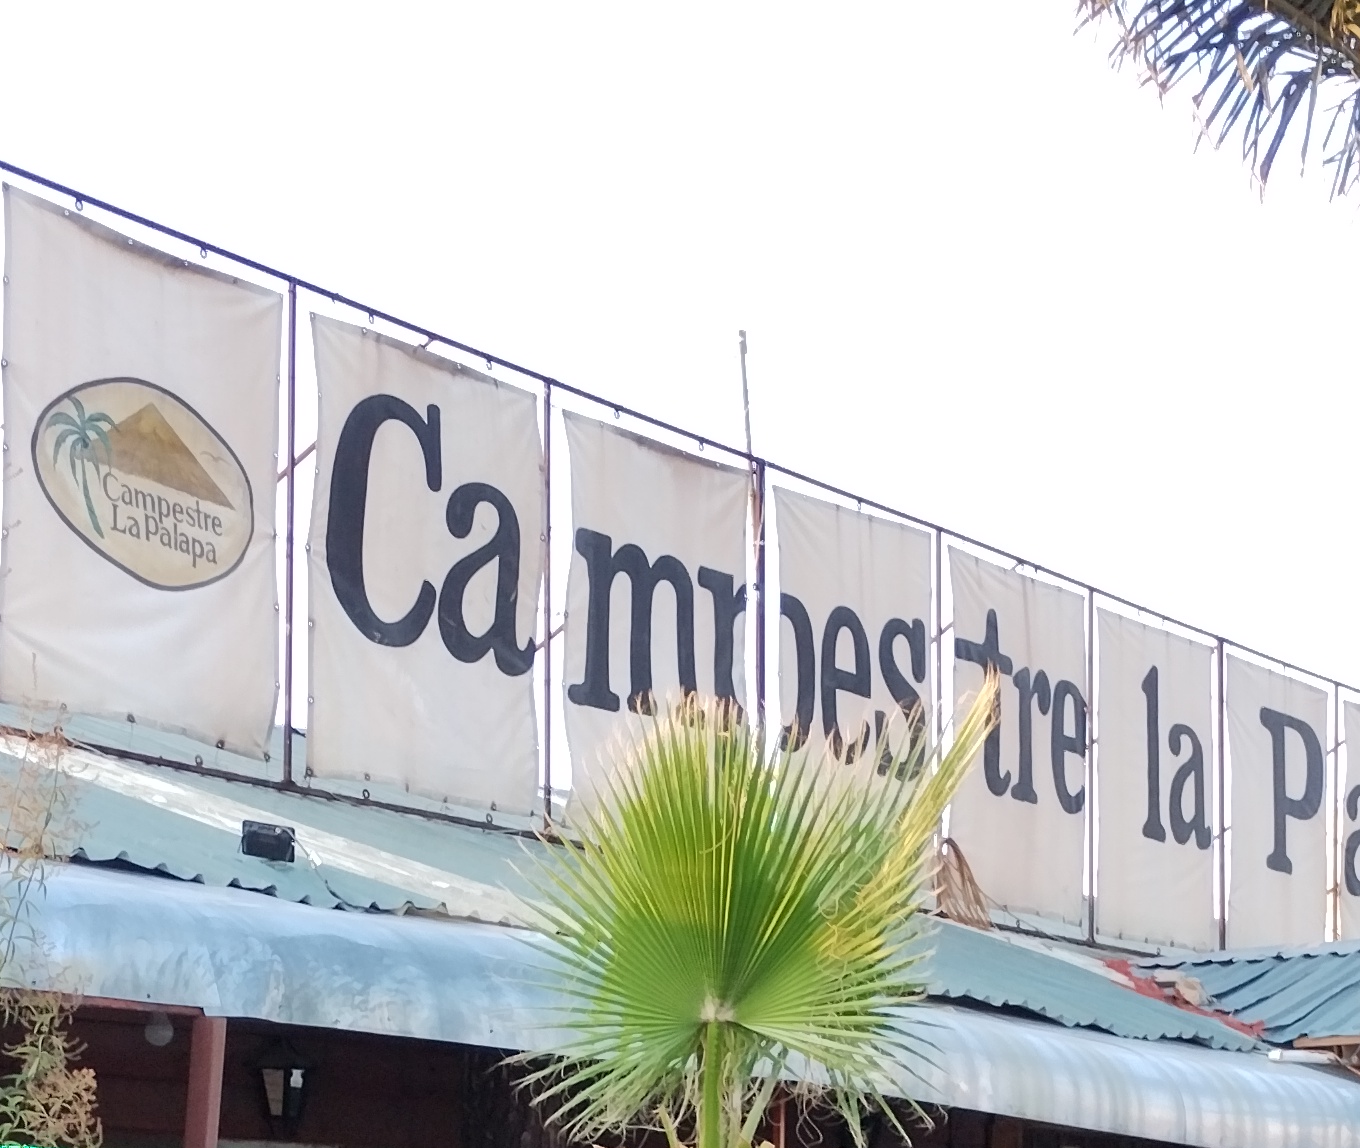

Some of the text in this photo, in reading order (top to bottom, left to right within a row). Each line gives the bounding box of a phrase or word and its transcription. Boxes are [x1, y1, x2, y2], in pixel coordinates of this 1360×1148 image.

[102, 471, 222, 536] Campestre
[110, 503, 218, 568] La Palapa
[325, 394, 1087, 814] Campestre
[1142, 665, 1211, 850] la
